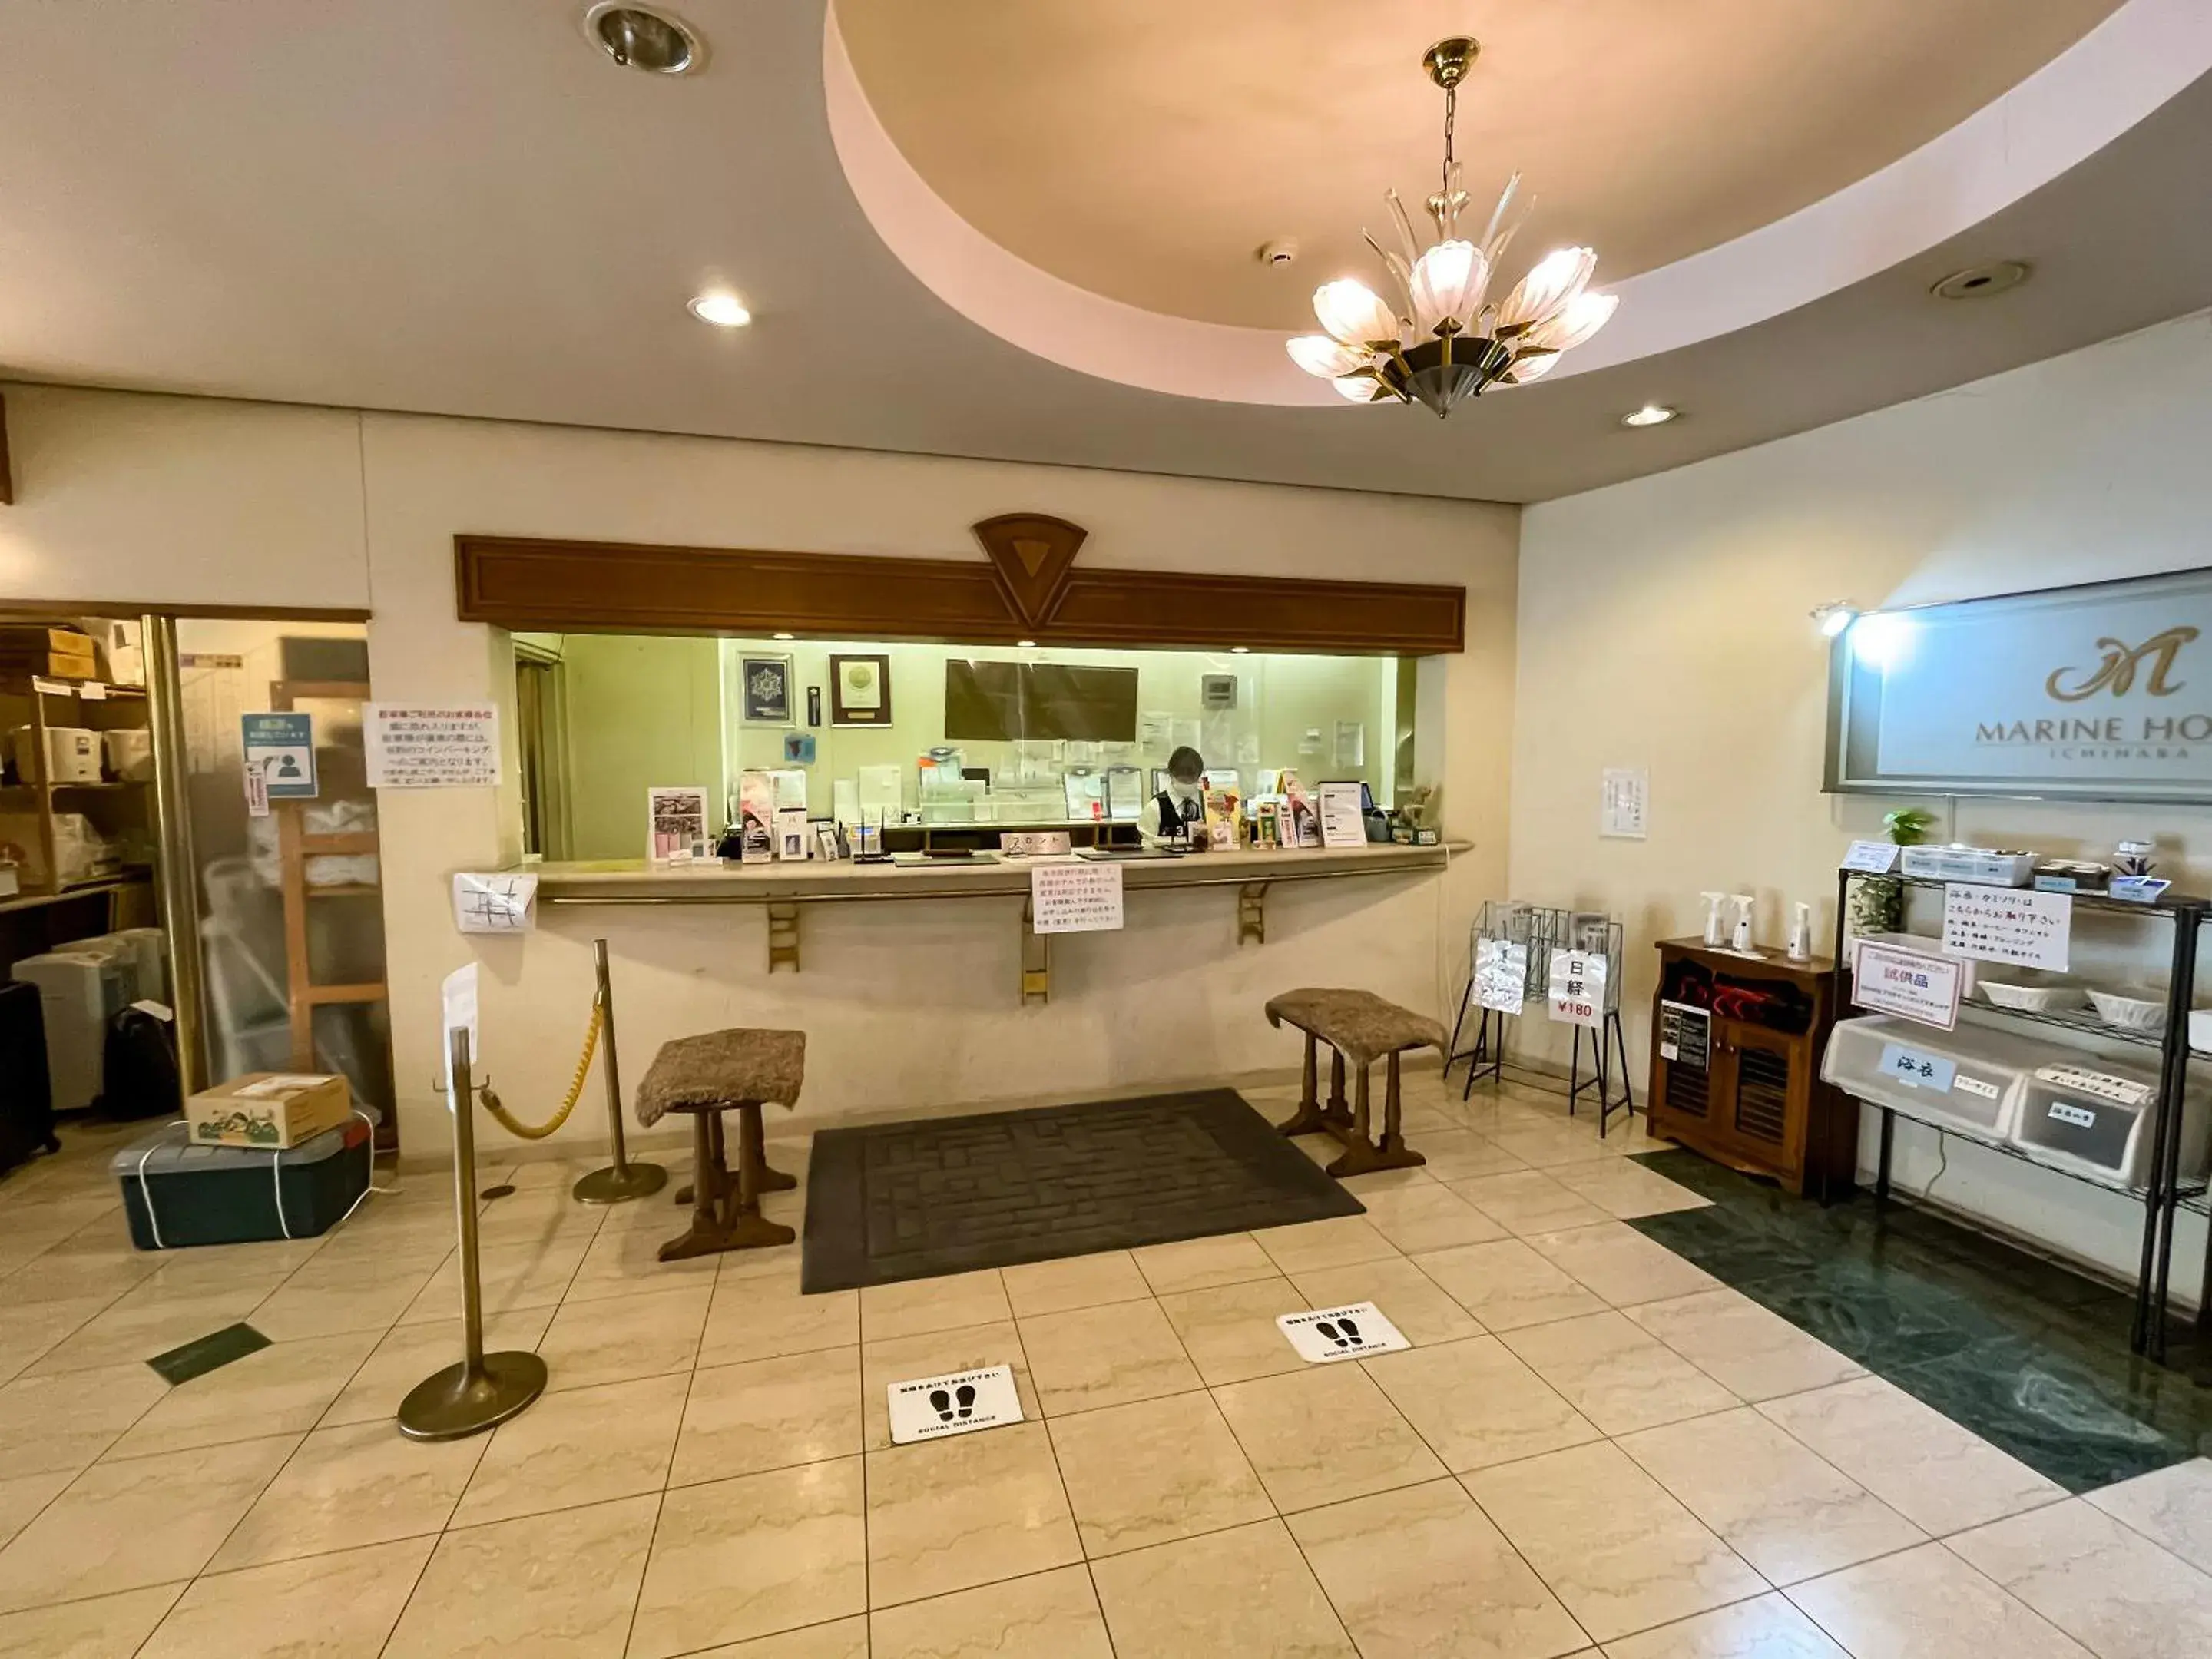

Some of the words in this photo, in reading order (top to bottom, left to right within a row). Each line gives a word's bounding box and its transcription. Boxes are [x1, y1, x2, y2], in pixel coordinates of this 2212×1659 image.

[1975, 717, 2124, 742] MARINE
[2050, 747, 2189, 760] ICHIHARA
[1884, 968, 1929, 988] 試供品
[1558, 1001, 1592, 1017] ¥180
[1897, 1056, 1933, 1077] 浴衣
[1324, 1349, 1349, 1358] SOCIAL
[1352, 1343, 1387, 1353] DISTANCE
[918, 1424, 949, 1434] SOCIAL
[953, 1415, 997, 1429] DISTANCE
